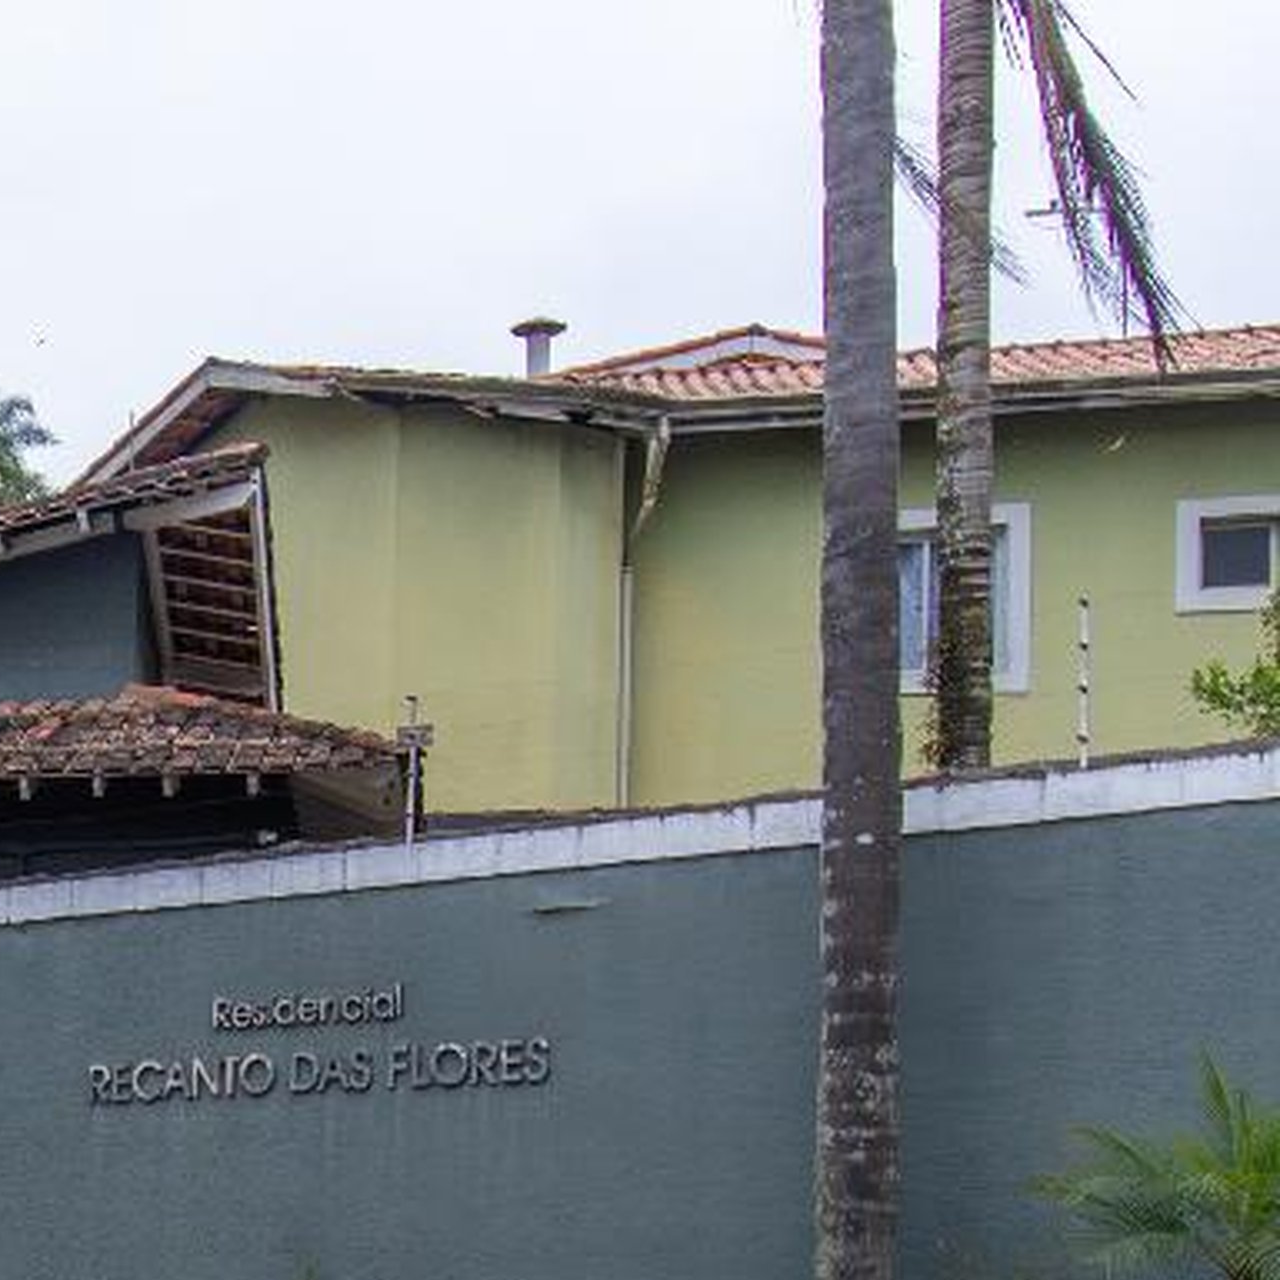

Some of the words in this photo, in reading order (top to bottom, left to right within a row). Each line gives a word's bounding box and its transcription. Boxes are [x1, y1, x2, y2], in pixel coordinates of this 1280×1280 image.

[212, 984, 404, 1030] Residencial
[88, 1052, 273, 1103] RECANTO
[289, 1047, 372, 1095] DAS
[387, 1037, 551, 1090] FLORES
